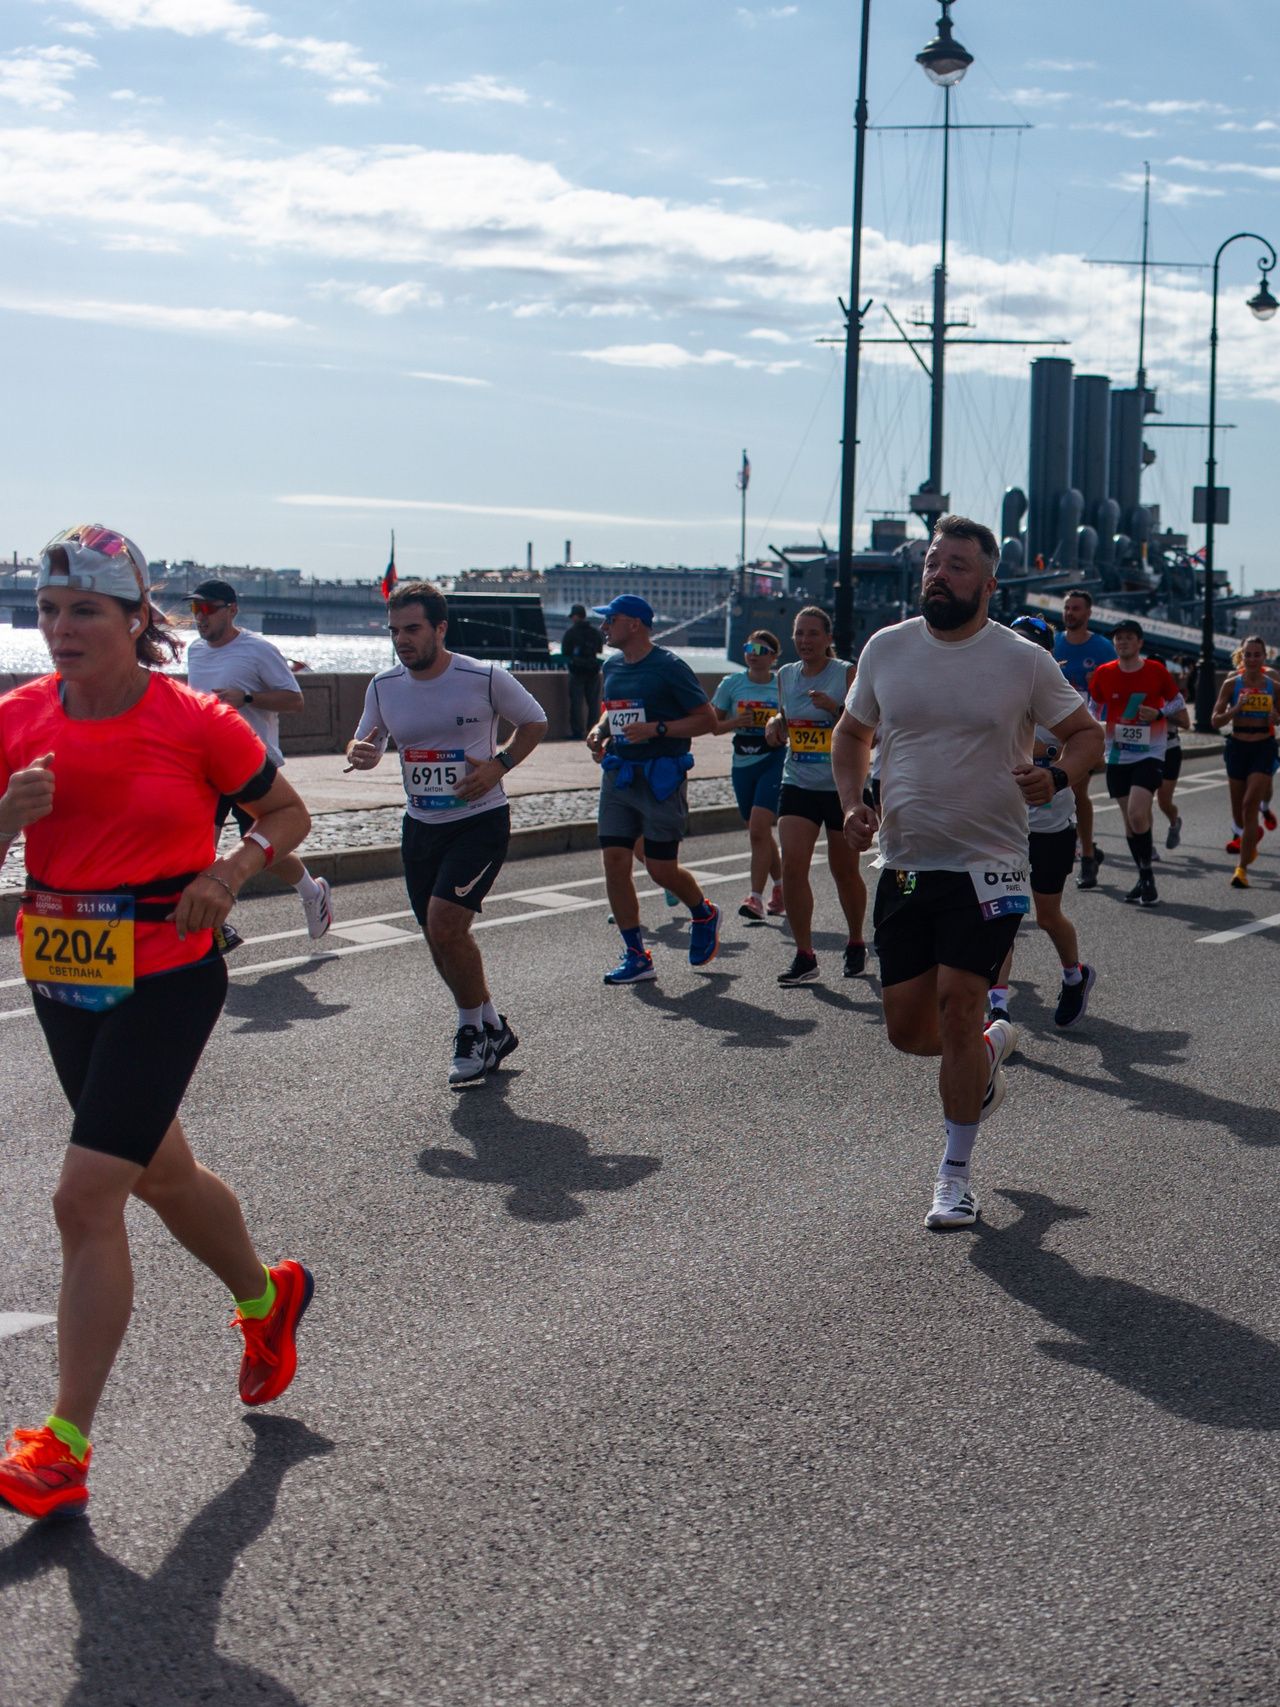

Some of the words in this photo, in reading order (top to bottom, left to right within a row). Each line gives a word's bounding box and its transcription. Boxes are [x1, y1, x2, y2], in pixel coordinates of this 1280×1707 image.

[1247, 696, 1269, 707] 212
[612, 712, 640, 727] 4377
[795, 731, 826, 745] 3941
[1122, 727, 1143, 739] 235
[411, 767, 457, 785] 6915
[412, 797, 420, 807] E
[1005, 884, 1022, 892] PAVEL
[35, 902, 62, 911] МАРАФОН
[76, 903, 95, 914] 21,1
[989, 901, 1001, 915] E
[33, 926, 117, 965] 2204
[48, 966, 102, 978] СВЕТЛАНА
